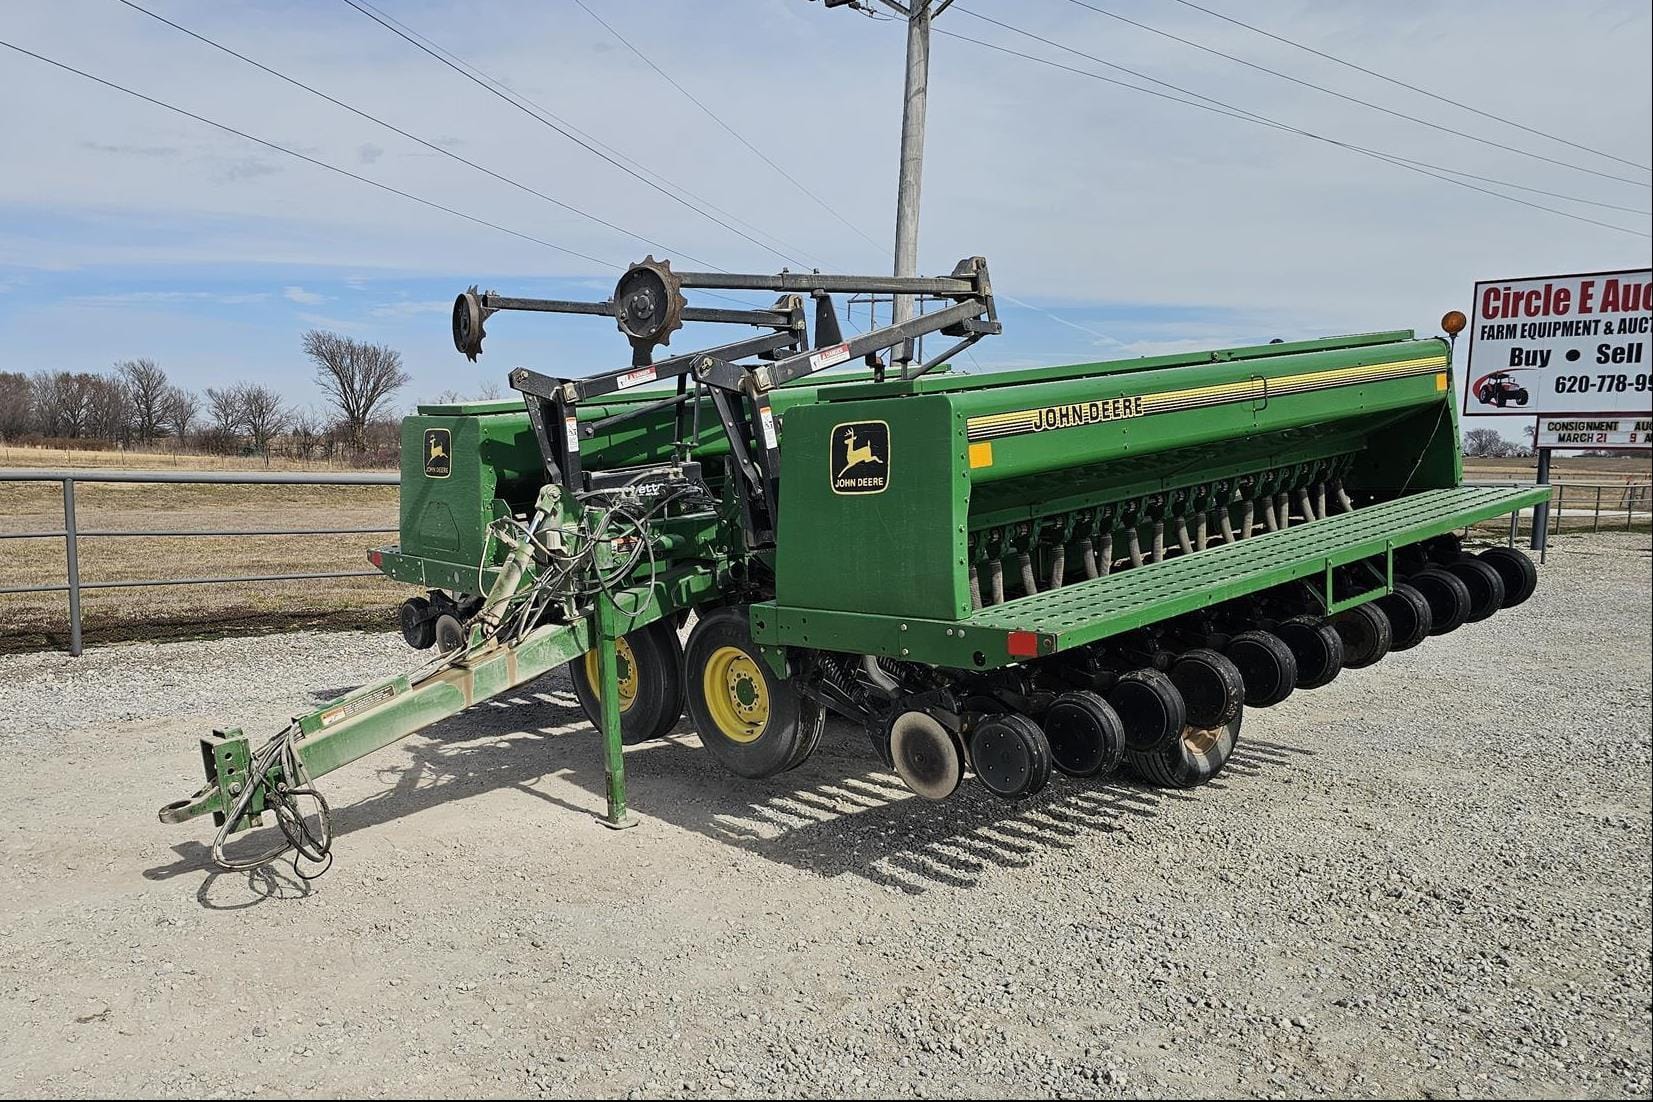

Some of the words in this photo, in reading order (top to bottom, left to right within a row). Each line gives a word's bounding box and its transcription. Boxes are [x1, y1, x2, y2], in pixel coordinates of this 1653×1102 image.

[1482, 284, 1571, 320] Circle
[1578, 281, 1595, 314] E
[1480, 324, 1517, 341] FARM
[1520, 319, 1601, 340] EQUIPMENT
[1603, 321, 1614, 336] &
[1509, 347, 1552, 368] Buy
[1595, 343, 1643, 365] Sell
[1033, 404, 1084, 431] JOHN
[1089, 397, 1143, 421] DEERE
[1547, 421, 1619, 432] CONSIGNMENT
[1557, 433, 1593, 443] MARCH
[1596, 433, 1607, 443] 21
[1629, 433, 1637, 443] 9
[835, 478, 856, 488] JOHN
[857, 477, 884, 487] DEERE
